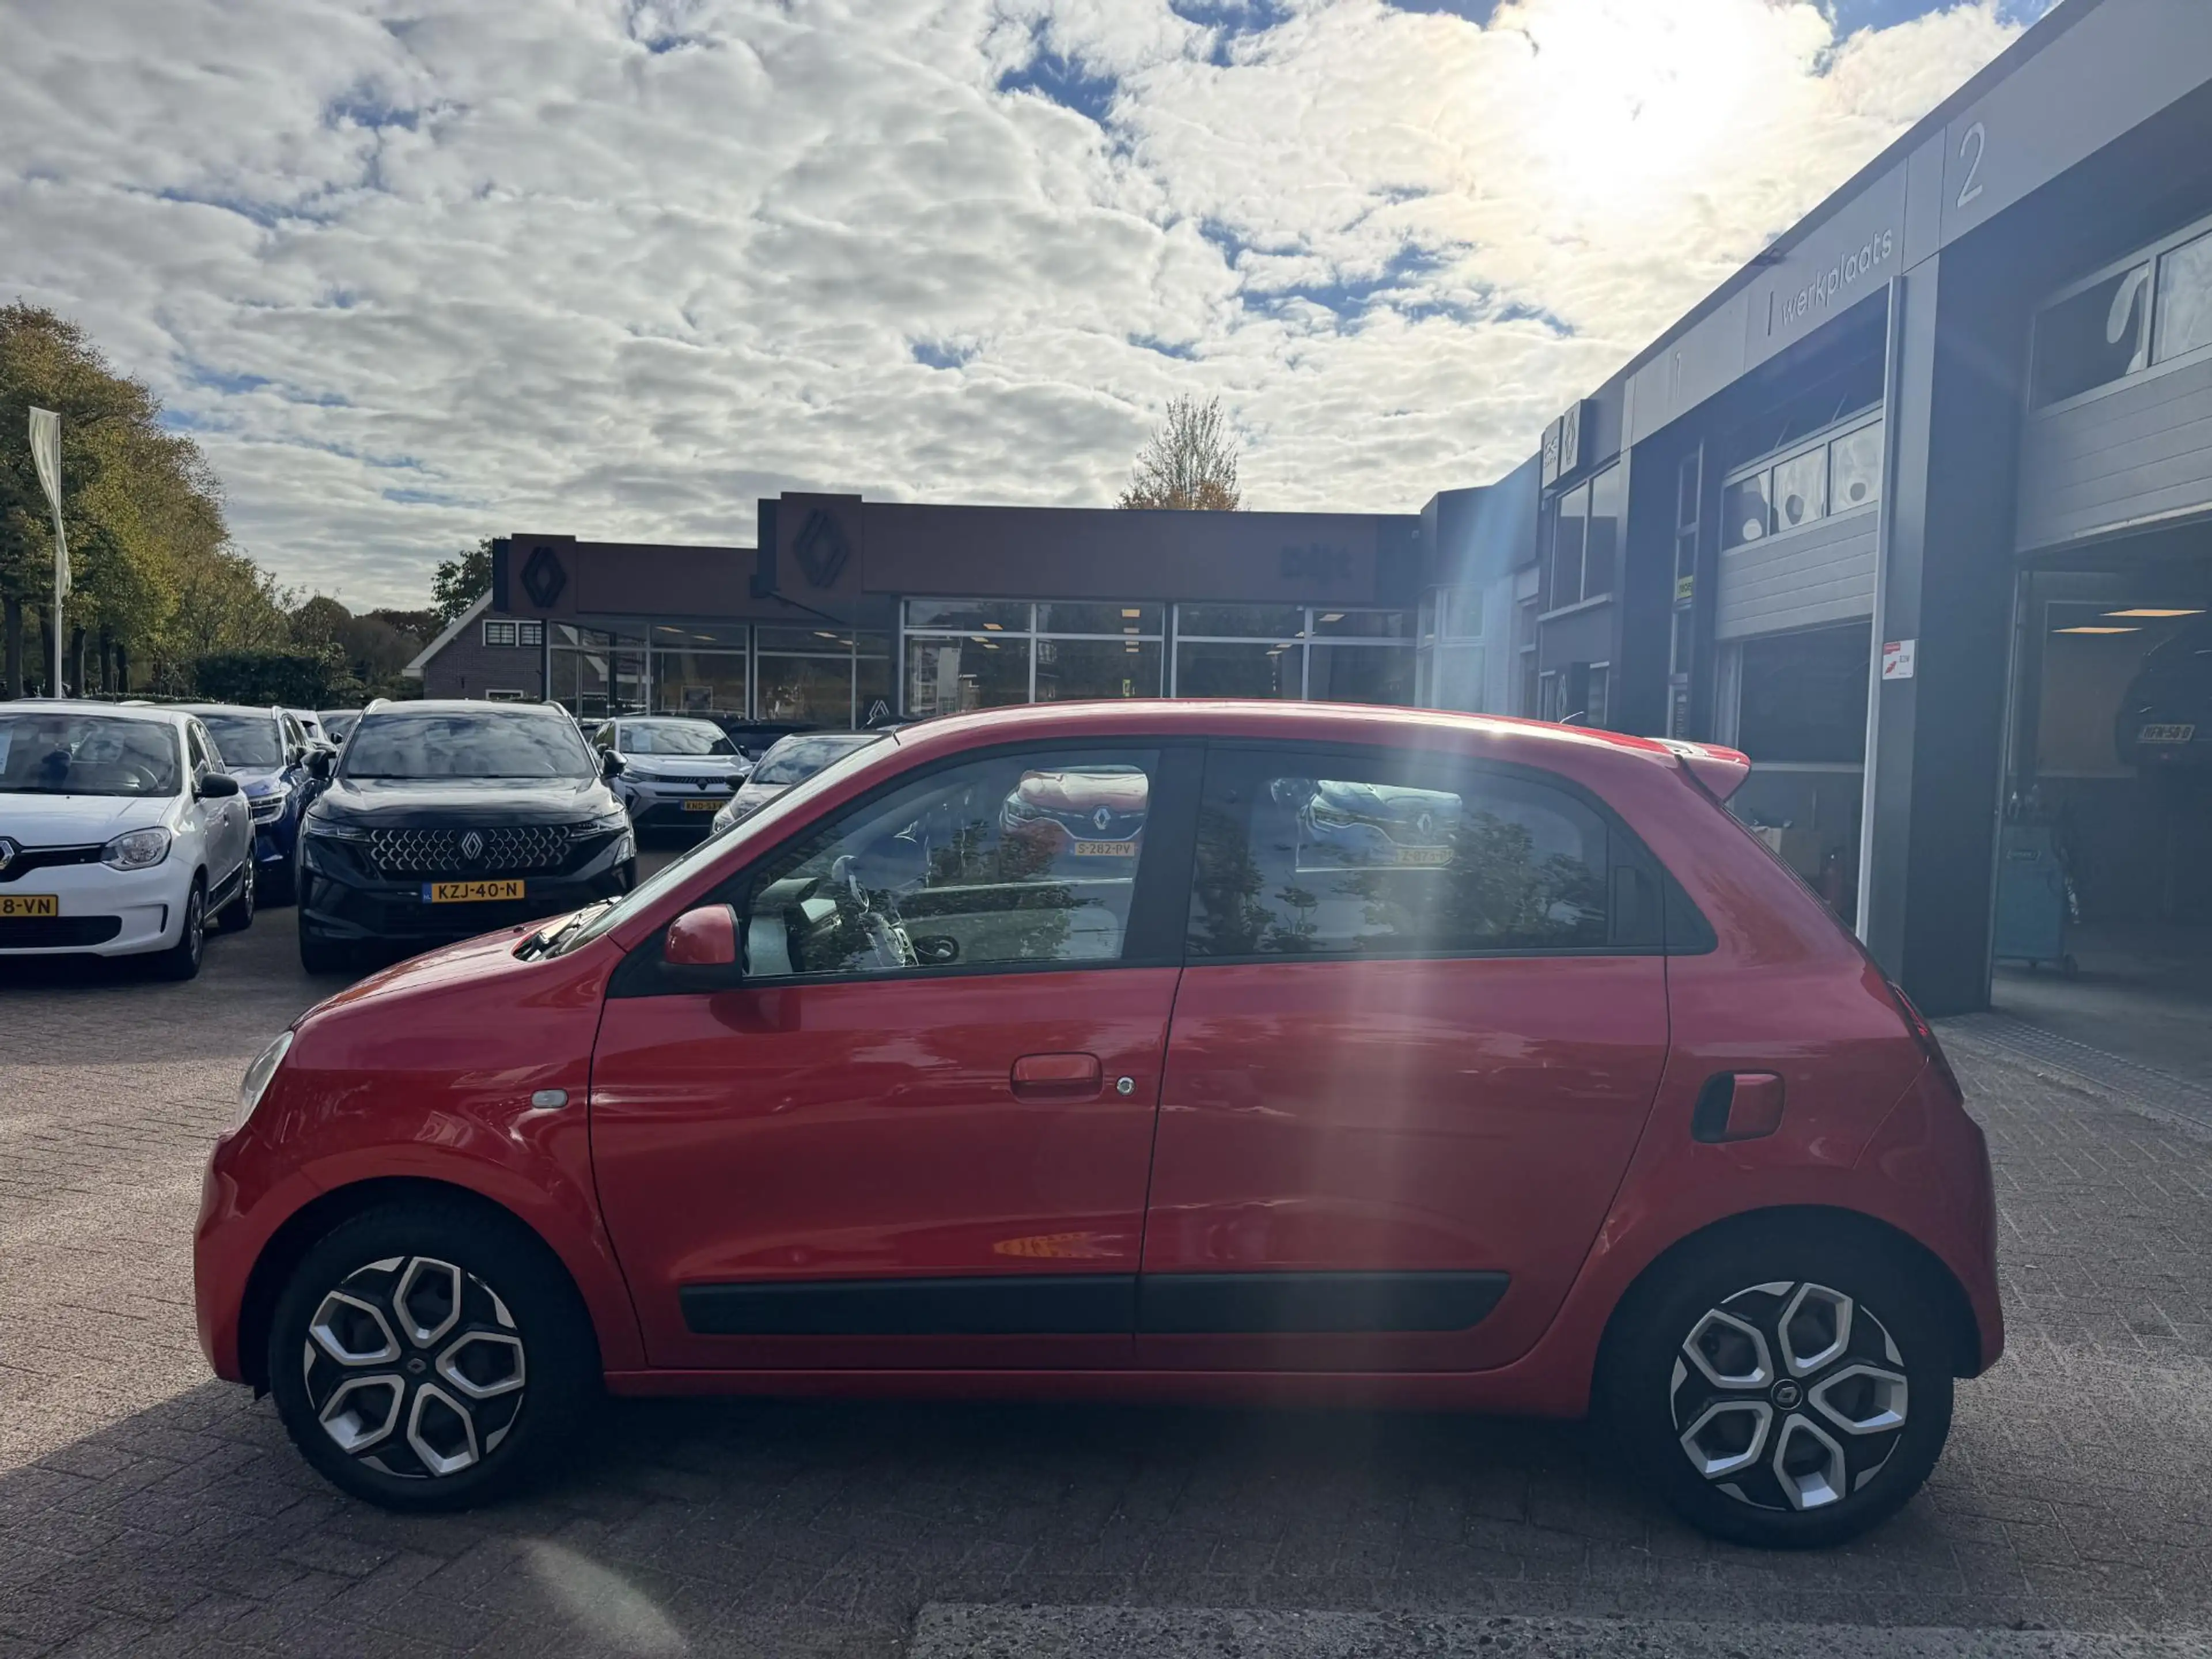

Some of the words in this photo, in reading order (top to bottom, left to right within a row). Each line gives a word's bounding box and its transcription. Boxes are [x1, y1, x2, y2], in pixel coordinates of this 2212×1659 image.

[1956, 122, 1985, 207] 2
[1782, 228, 1892, 325] werkplaats
[1078, 843, 1130, 854] S-282-PV
[438, 882, 517, 899] KZJ-40-N
[3, 899, 50, 914] 8-VN
